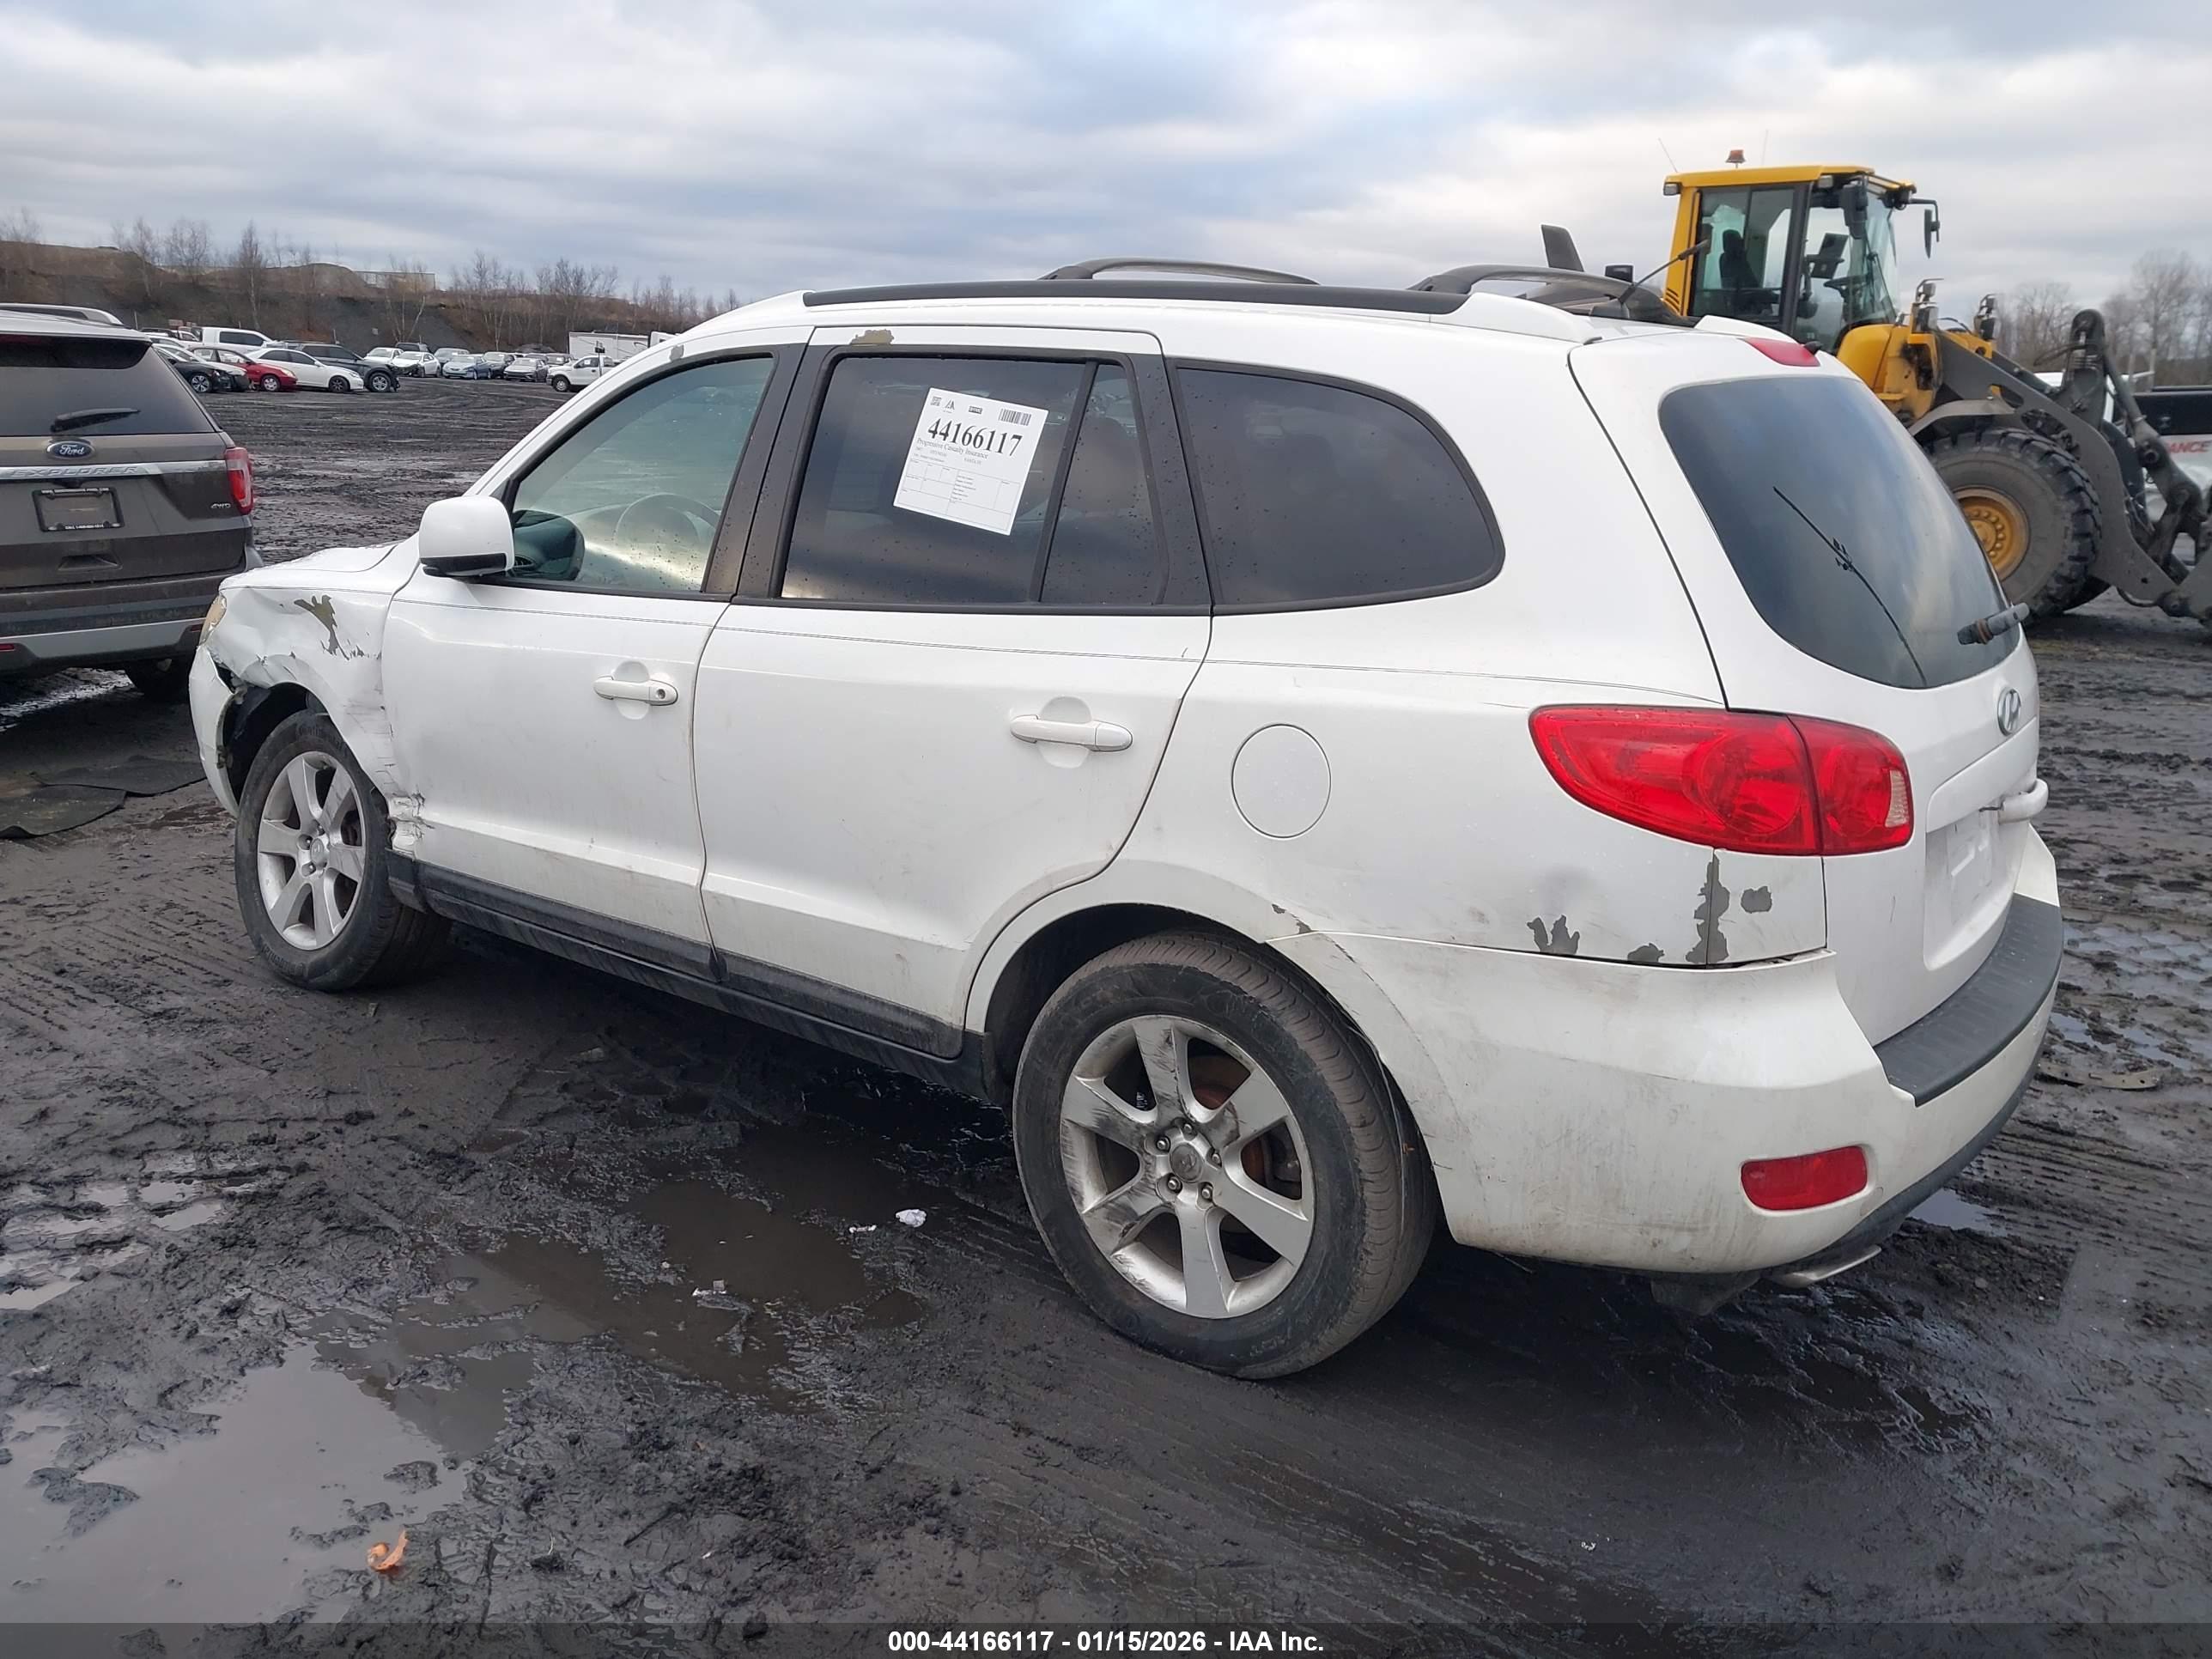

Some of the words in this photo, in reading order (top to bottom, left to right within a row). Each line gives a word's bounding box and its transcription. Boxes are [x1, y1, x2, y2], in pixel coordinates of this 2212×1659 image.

[928, 418, 1023, 456] 44166117
[59, 444, 85, 455] Ford
[12, 466, 137, 477] EXPLORER
